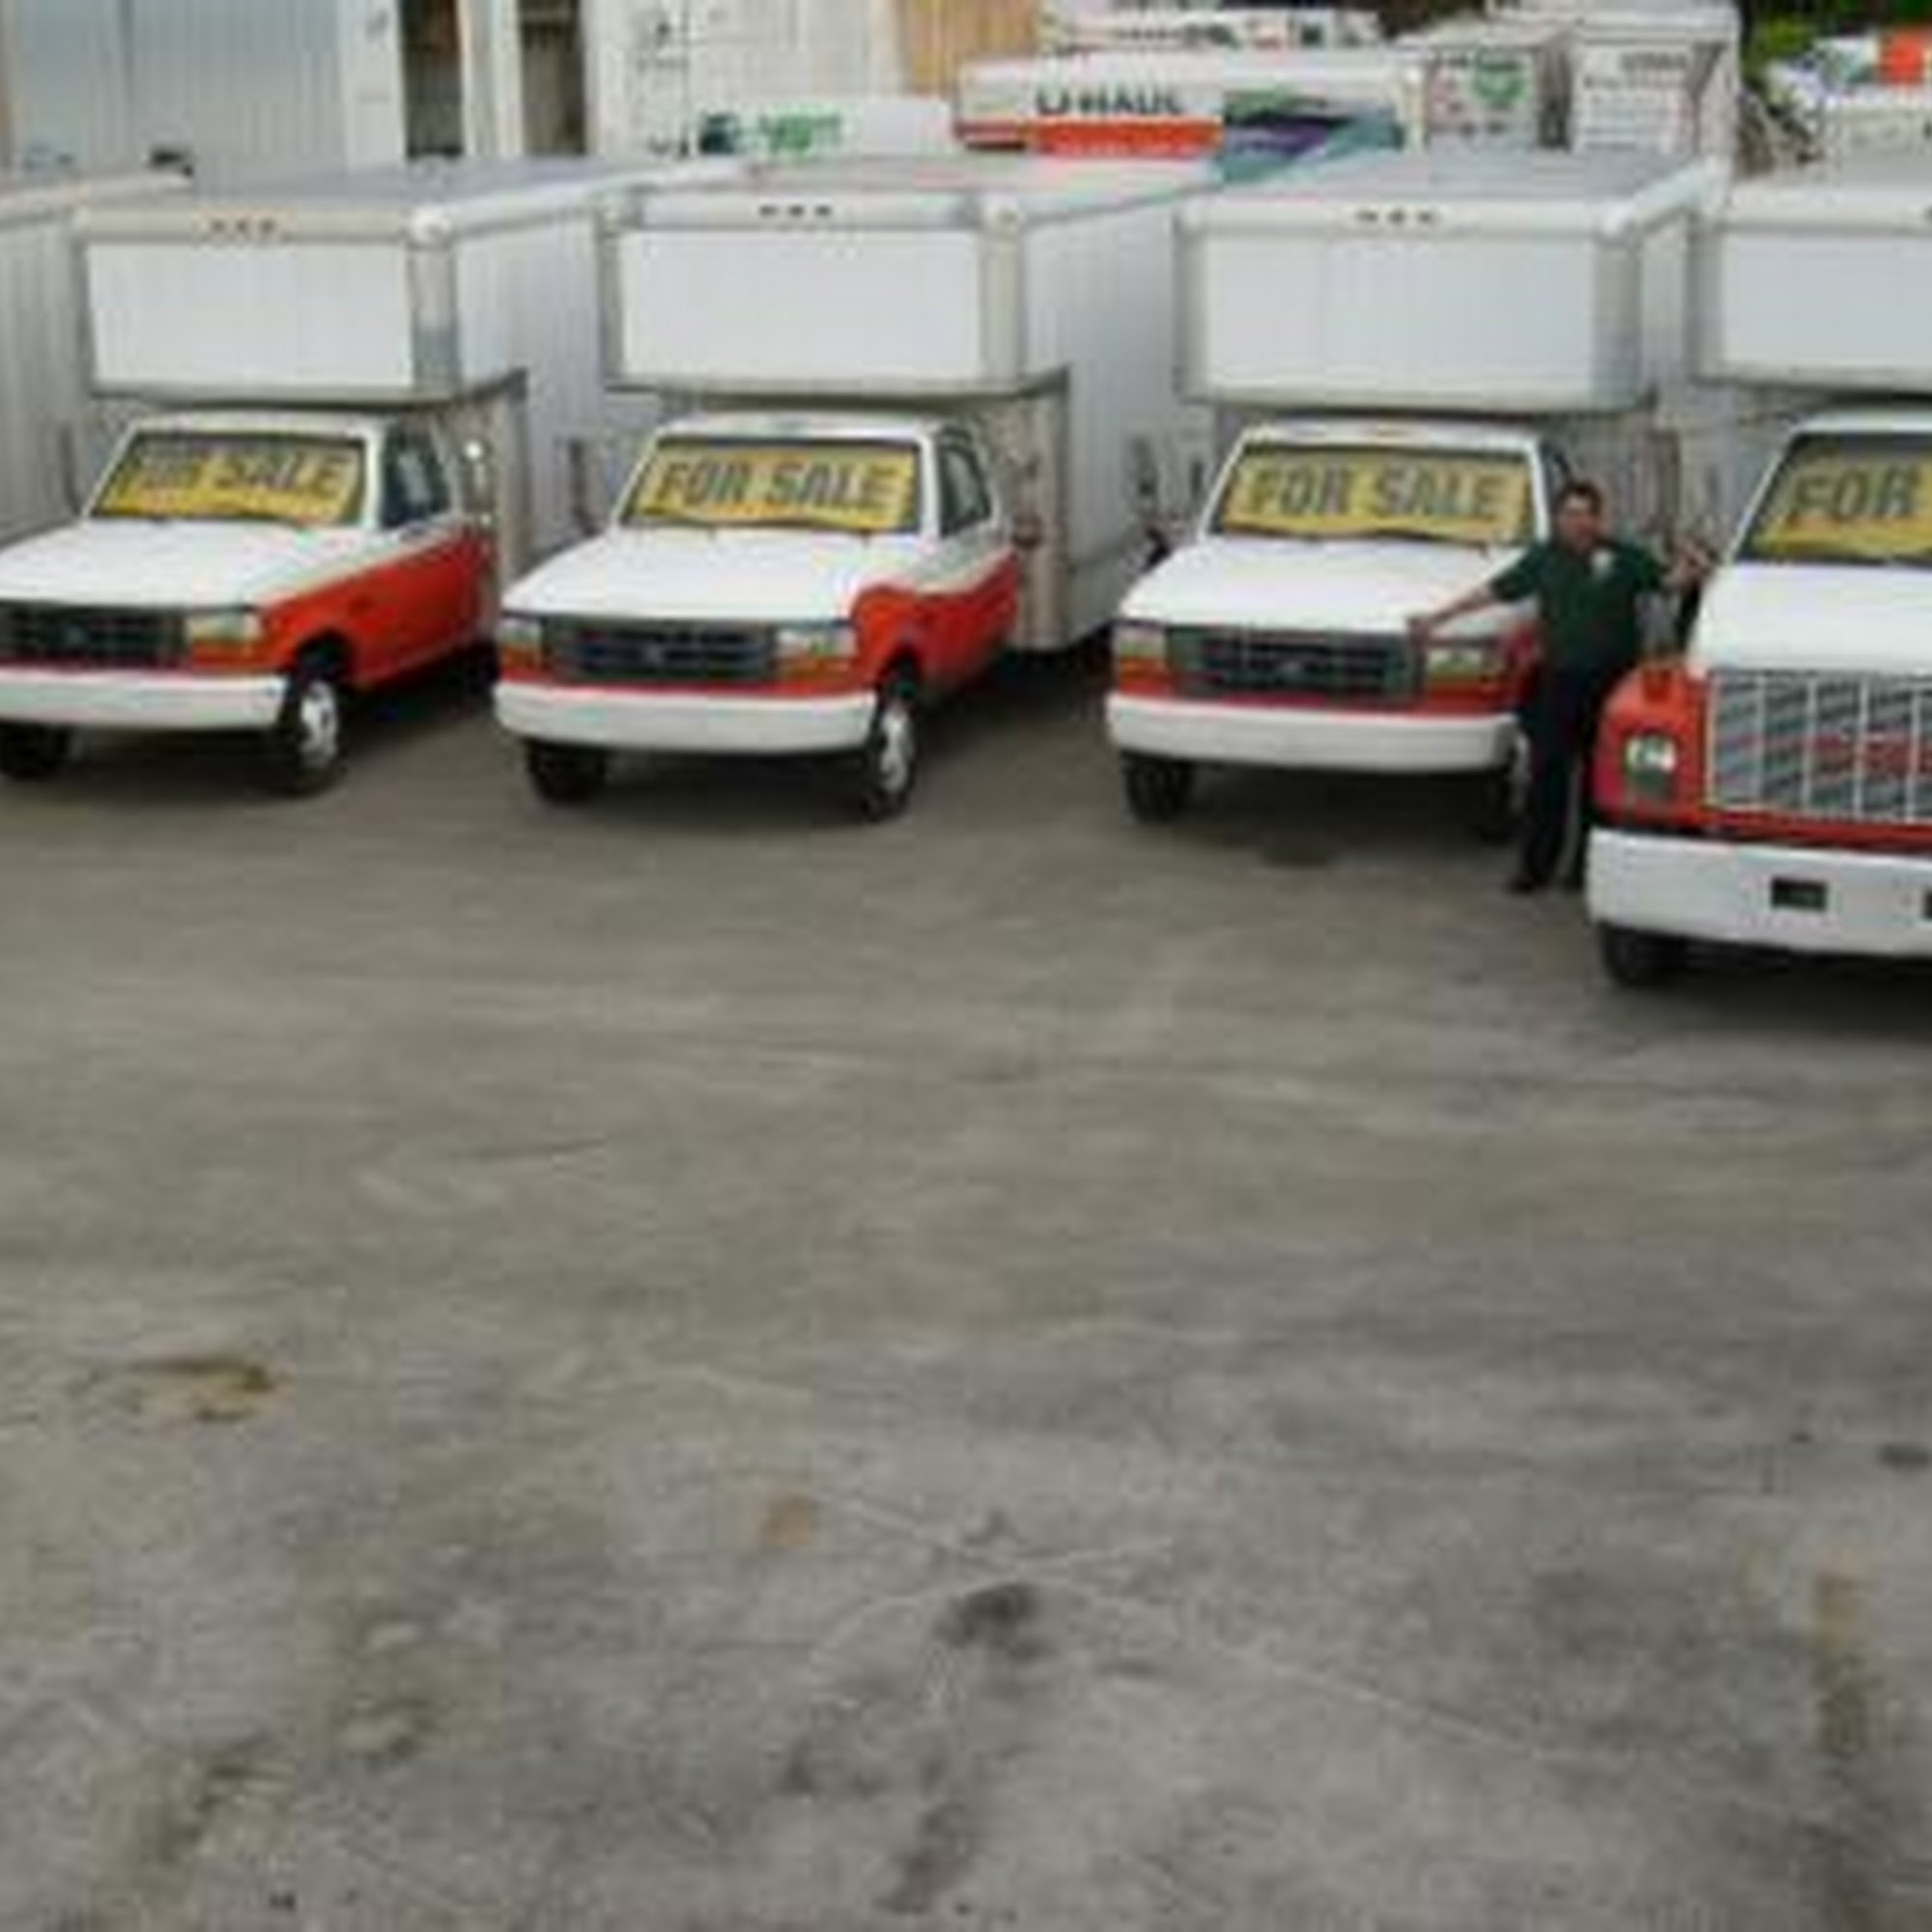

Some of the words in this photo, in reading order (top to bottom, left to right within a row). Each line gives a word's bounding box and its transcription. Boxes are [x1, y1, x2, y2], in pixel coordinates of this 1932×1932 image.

[220, 446, 352, 496] SALE
[649, 460, 751, 508] FOR
[766, 460, 900, 514] SALE
[1248, 468, 1350, 515] FOR
[1372, 469, 1502, 522] SALE
[1789, 468, 1919, 523] FOR
